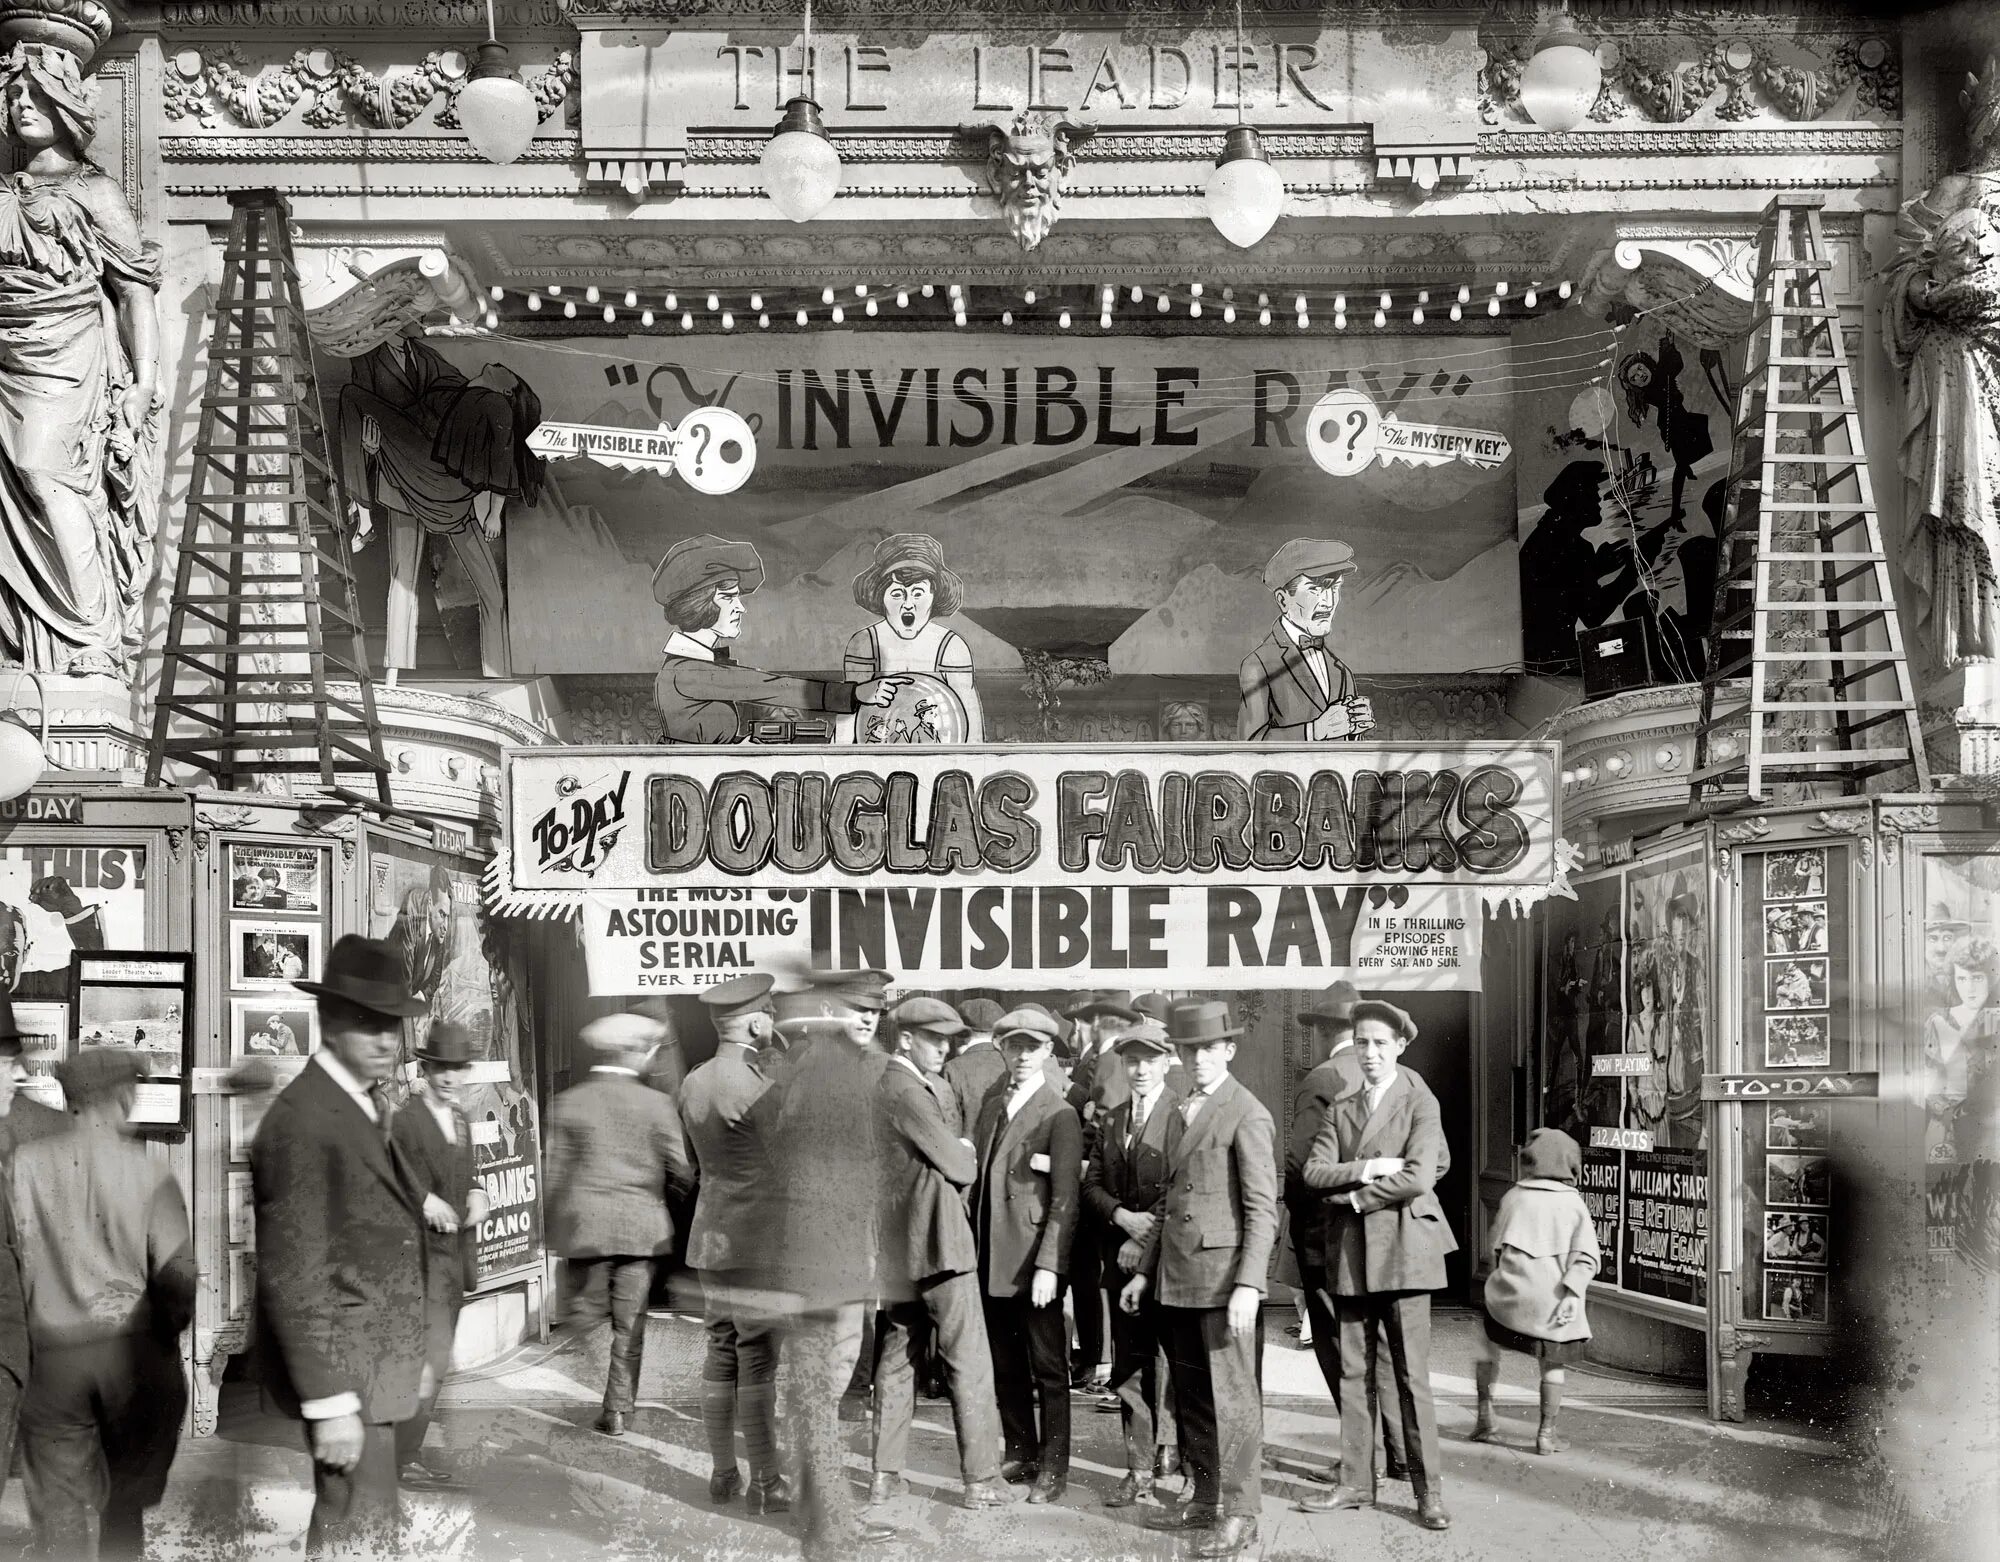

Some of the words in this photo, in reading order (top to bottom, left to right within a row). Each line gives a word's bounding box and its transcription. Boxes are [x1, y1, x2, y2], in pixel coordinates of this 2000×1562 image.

[716, 45, 891, 111] THE
[971, 44, 1332, 112] LEADER
[774, 366, 1200, 450] INVISIBLE
[572, 432, 643, 454] INVISIBLE
[1410, 431, 1472, 454] MYSTERY
[644, 769, 1042, 876] DOUGLAS
[1056, 764, 1530, 875] FAIRBANKS
[435, 829, 465, 853] TO-DAY
[1600, 837, 1632, 866] TO-DAY
[236, 847, 251, 857] THE
[253, 849, 294, 859] INVISIBLE
[296, 851, 314, 861] RAY
[23, 848, 146, 889] THIS!
[606, 907, 798, 937] ASTOUNDING
[1368, 917, 1380, 929] IN
[1386, 918, 1397, 929] 15
[1403, 918, 1466, 930] THRILLING
[1384, 932, 1446, 944] EPISODES
[639, 941, 755, 969] SERIAL
[1376, 945, 1428, 956] SHOWING
[1431, 946, 1458, 956] HERE
[1358, 957, 1384, 968] EVERY
[1390, 958, 1409, 968] SAT.
[1412, 958, 1433, 967] AND
[1437, 958, 1461, 967] SUN.
[638, 974, 685, 986] EVER
[1593, 1058, 1612, 1073] NOW
[1614, 1056, 1650, 1073] PLAYING
[1720, 1077, 1868, 1096] TO-DAY
[1595, 1129, 1608, 1147] 12
[1610, 1131, 1648, 1150] ACTS
[1629, 1169, 1671, 1197] WILLIAM
[1604, 1194, 1619, 1213] OF
[1628, 1199, 1644, 1219] THE
[1645, 1198, 1694, 1234] RETURN
